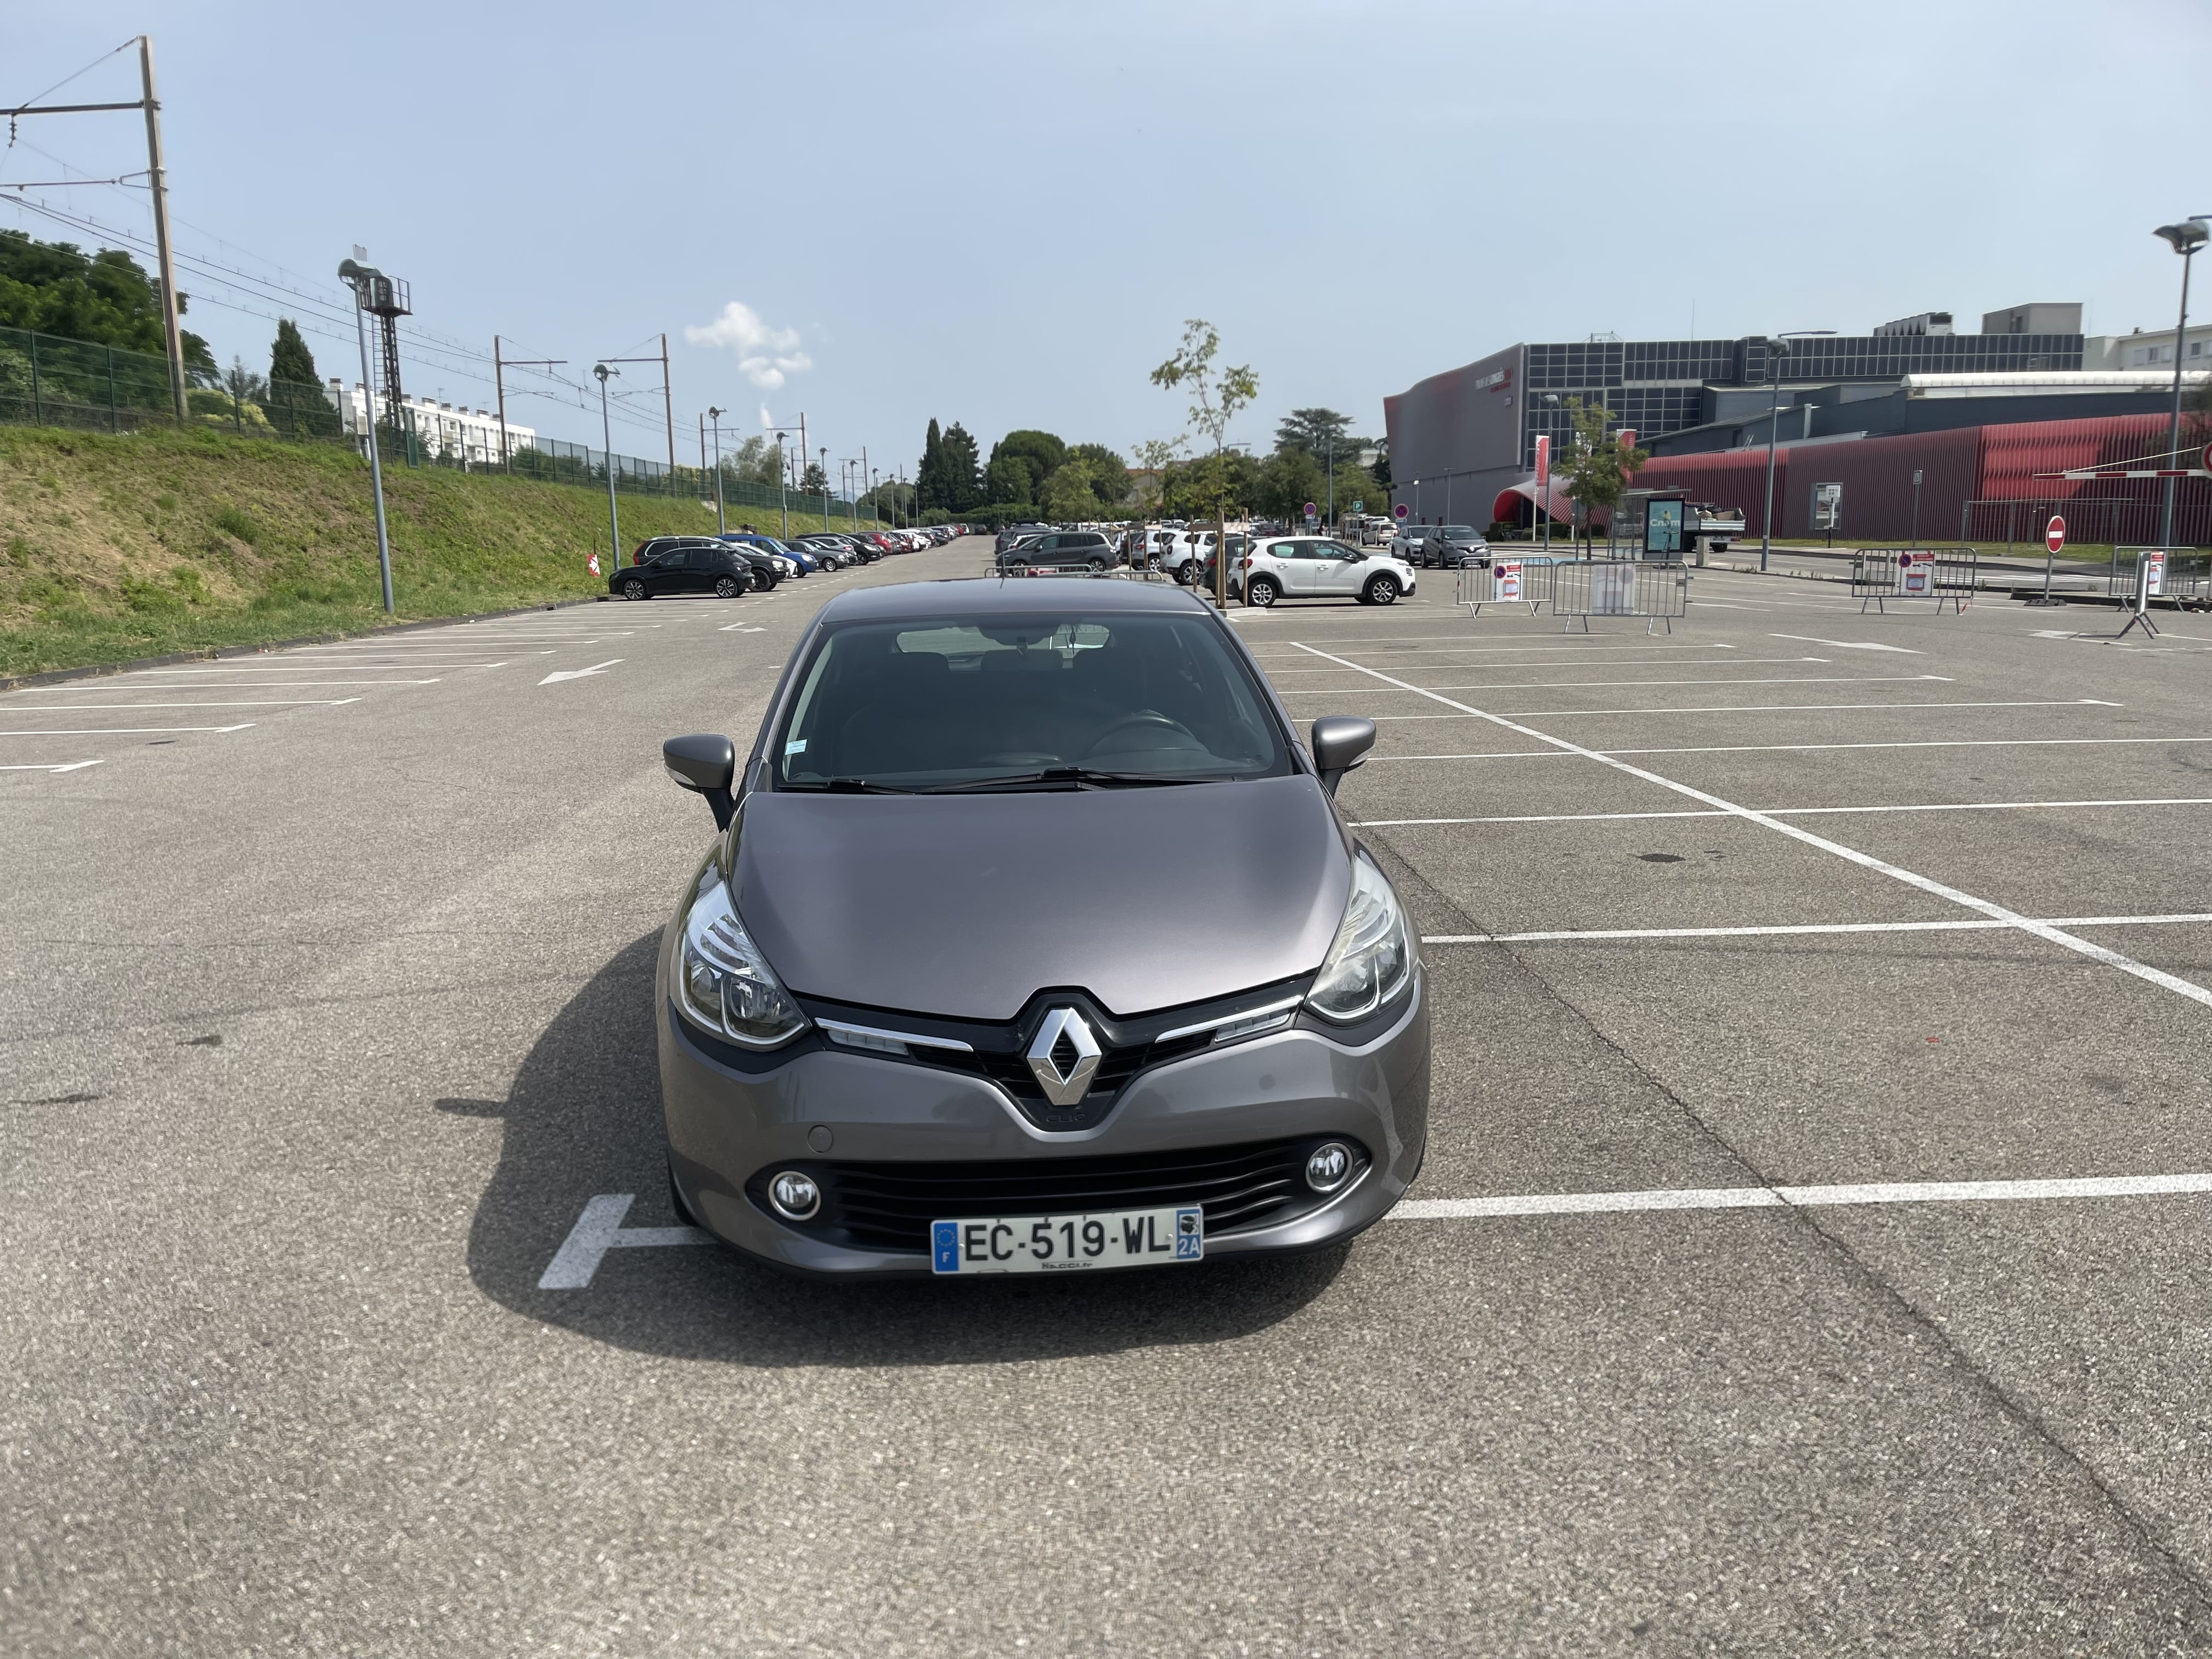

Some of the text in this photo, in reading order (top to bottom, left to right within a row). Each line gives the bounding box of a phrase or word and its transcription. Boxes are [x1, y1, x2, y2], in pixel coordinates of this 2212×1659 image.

[1046, 1113, 1087, 1124] CLIO
[965, 1216, 1171, 1261] EC-519-WL
[1178, 1238, 1201, 1256] 2A
[941, 1252, 950, 1262] F
